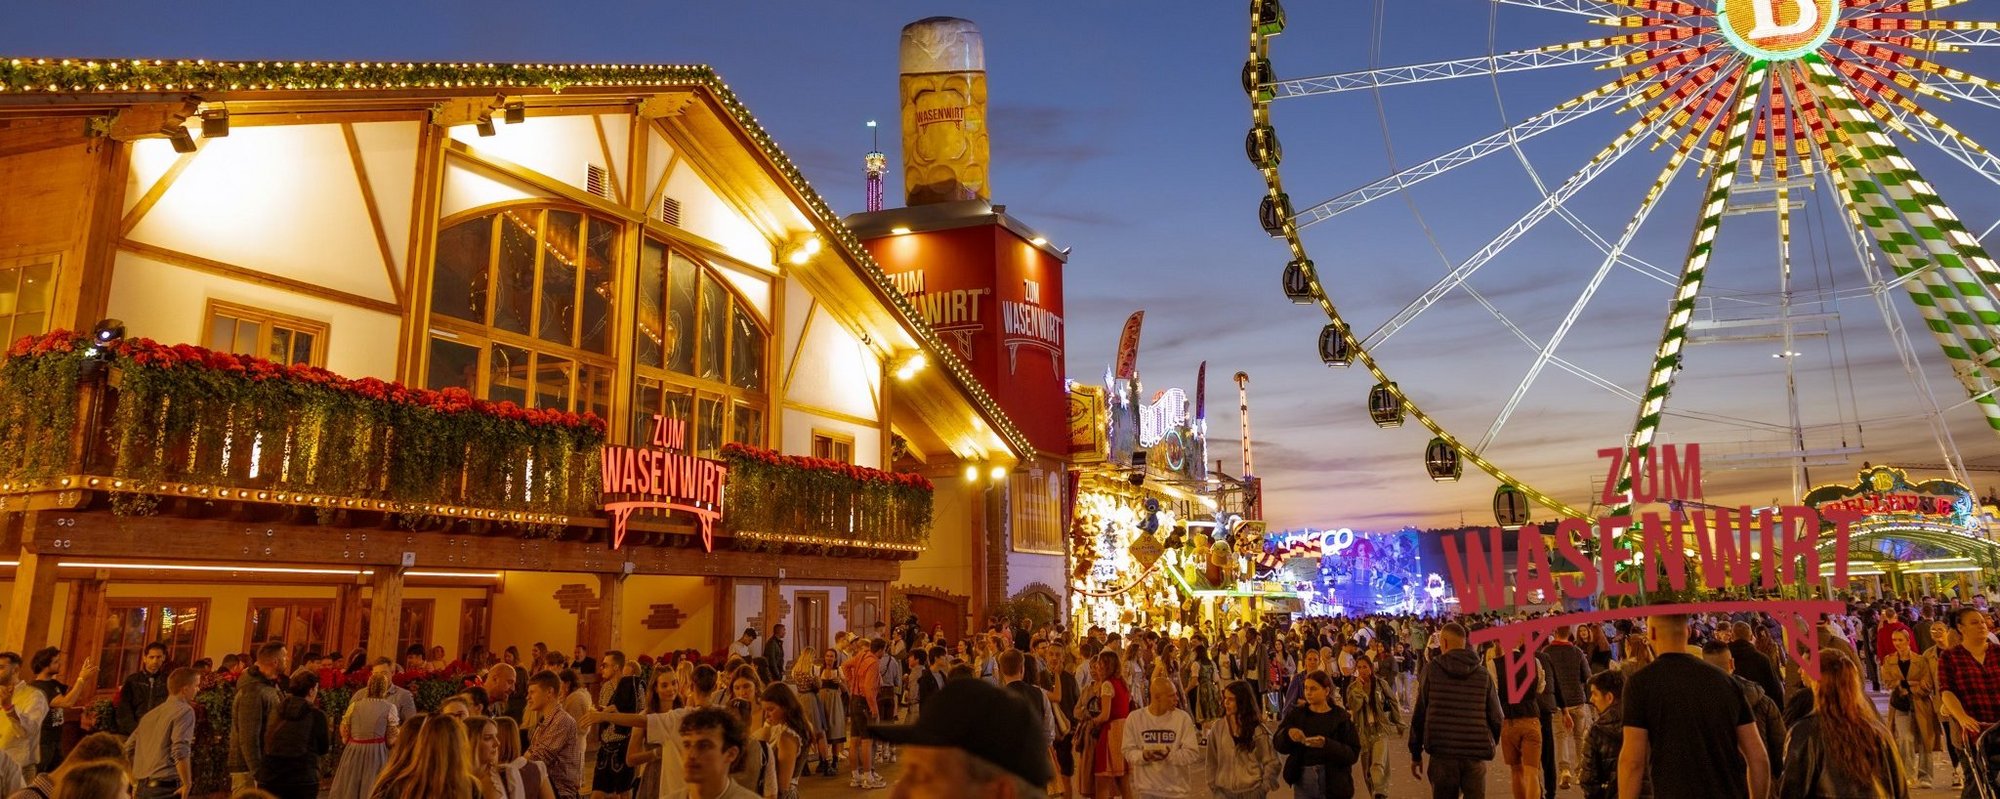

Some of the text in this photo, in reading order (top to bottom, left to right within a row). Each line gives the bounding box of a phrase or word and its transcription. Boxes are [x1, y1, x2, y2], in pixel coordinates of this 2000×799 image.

[916, 107, 964, 123] WASENWIRT
[1023, 278, 1040, 304] ZUM
[653, 414, 685, 450] ZUM
[600, 446, 727, 507] WASENWIRT
